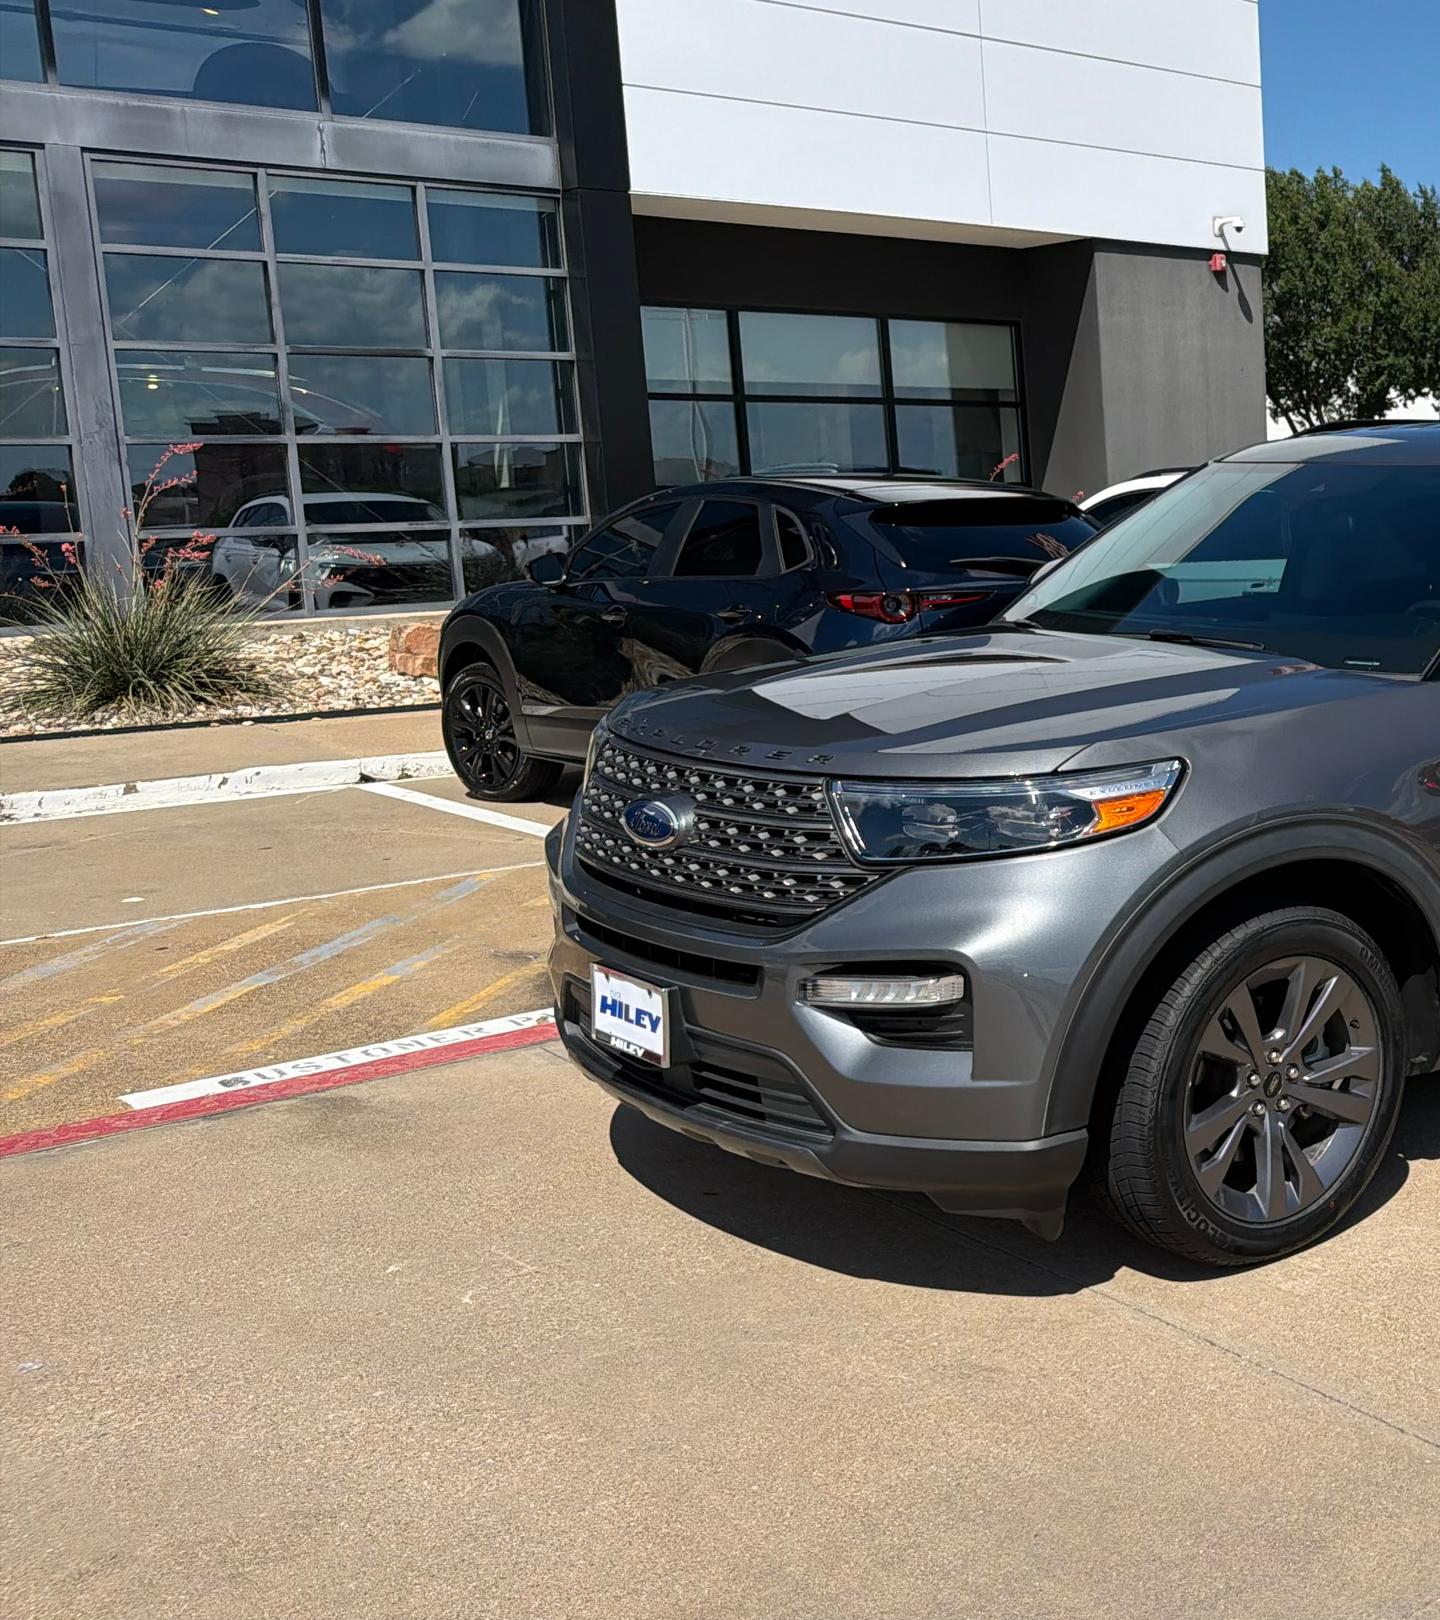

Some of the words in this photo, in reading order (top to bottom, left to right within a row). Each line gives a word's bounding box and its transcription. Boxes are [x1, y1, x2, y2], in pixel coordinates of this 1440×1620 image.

[616, 717, 834, 765] EXPLORER
[629, 810, 661, 837] Ford
[600, 994, 661, 1034] HILEY
[610, 1035, 645, 1058] HILEY
